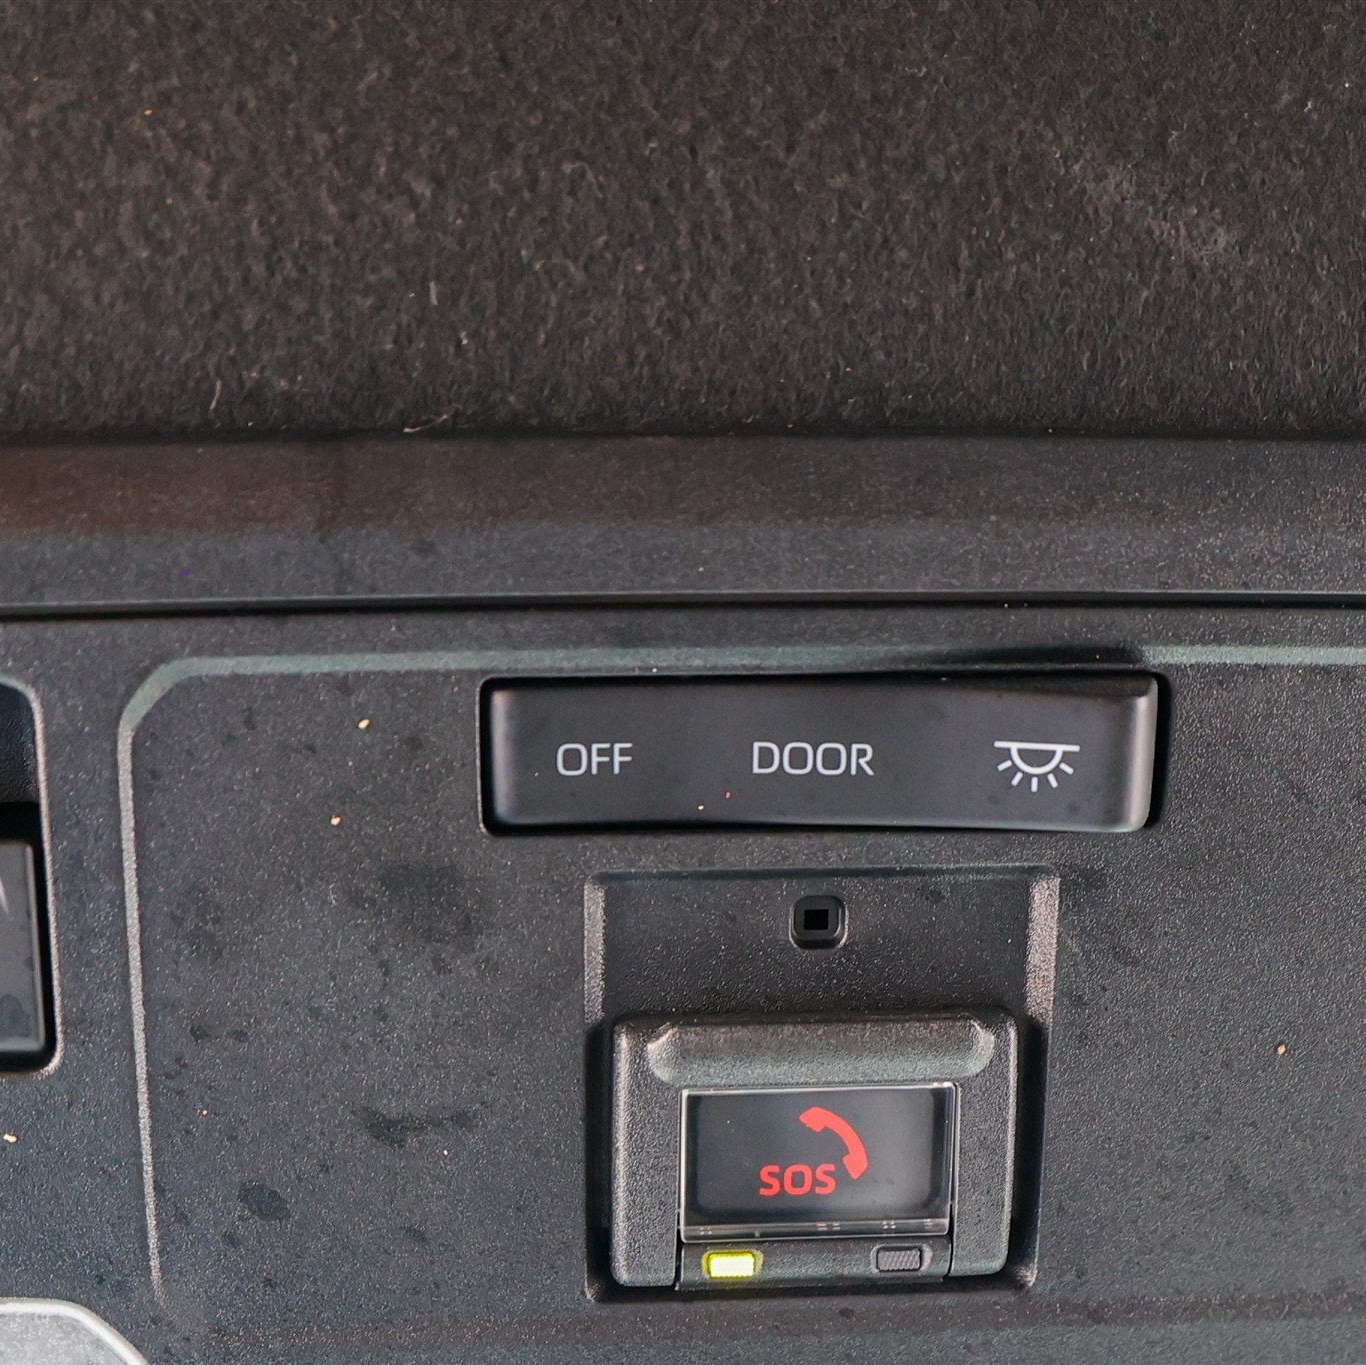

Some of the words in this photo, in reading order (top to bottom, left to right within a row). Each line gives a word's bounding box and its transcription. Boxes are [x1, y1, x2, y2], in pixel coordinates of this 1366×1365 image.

[556, 742, 633, 776] OFF
[752, 741, 875, 776] DOOR
[758, 1163, 837, 1197] SOS
